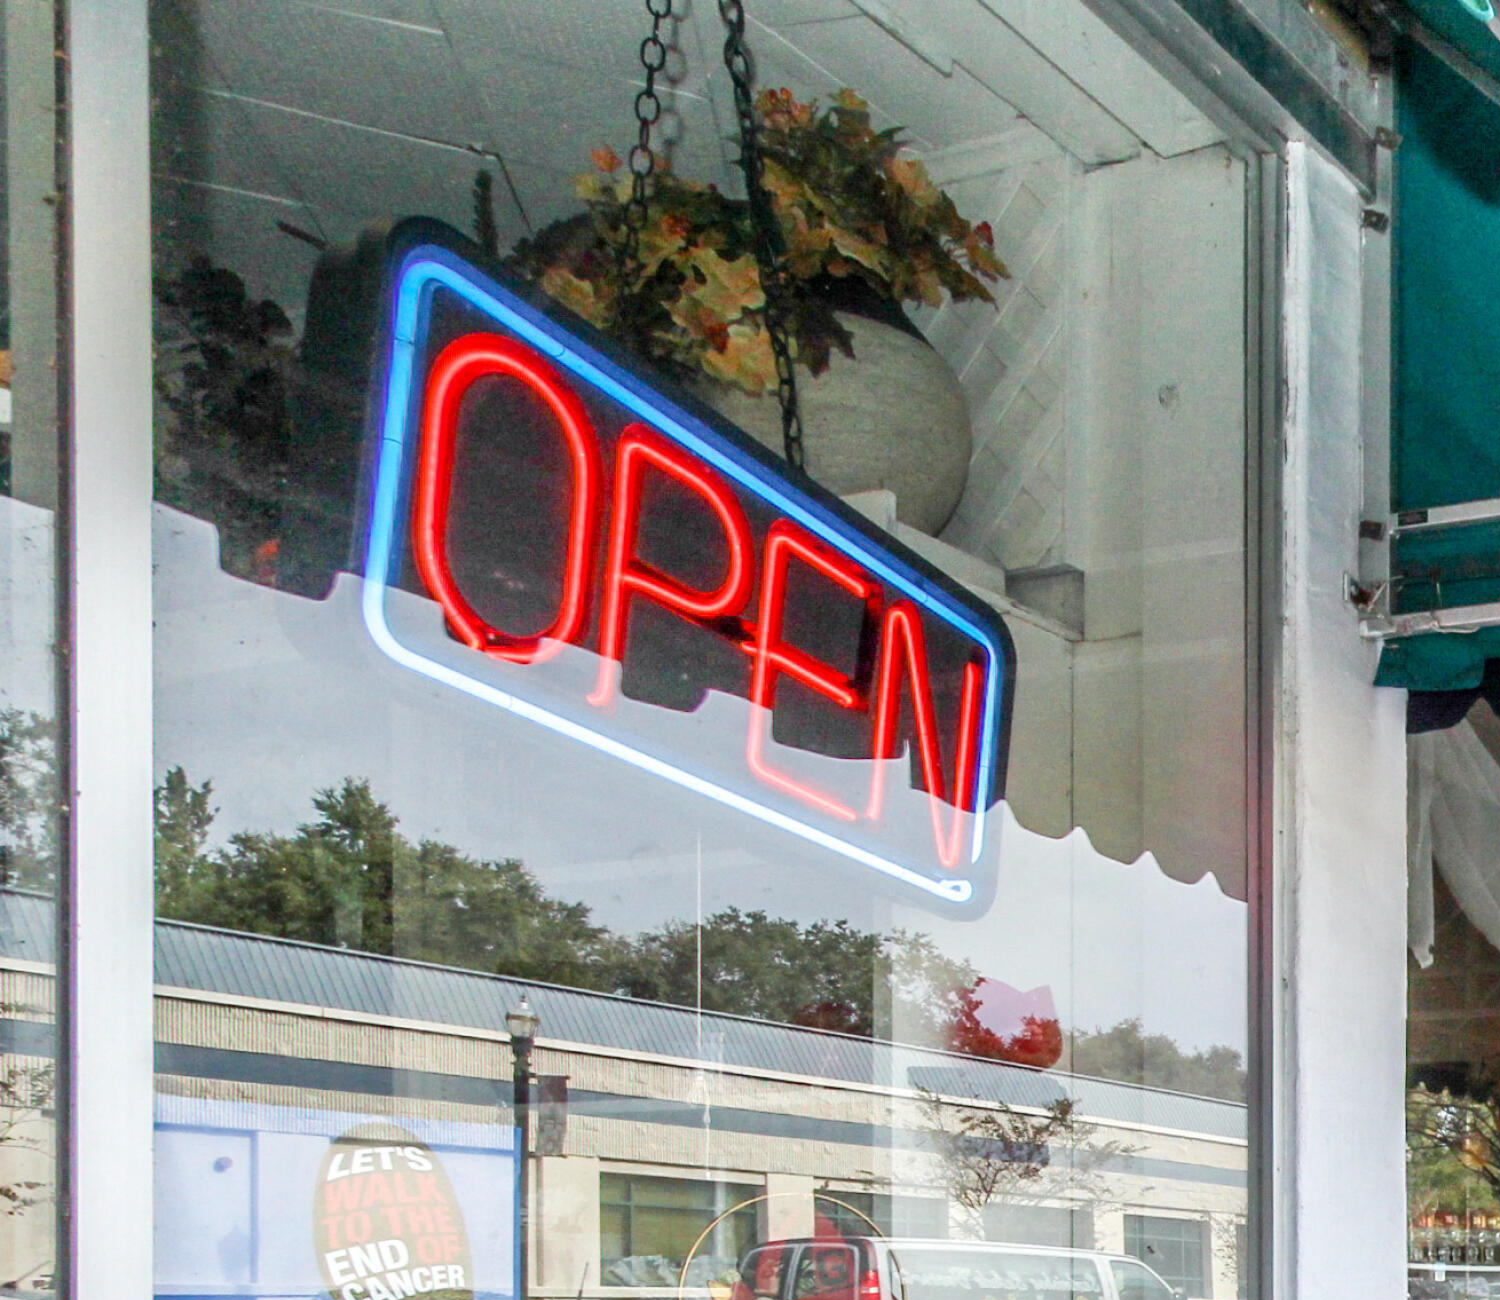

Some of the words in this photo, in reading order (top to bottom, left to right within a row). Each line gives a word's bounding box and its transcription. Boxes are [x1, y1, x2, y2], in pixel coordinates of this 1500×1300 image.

[413, 332, 981, 867] OPEN
[326, 1146, 433, 1182] LET'S
[323, 1172, 445, 1214] WALK
[321, 1210, 373, 1250] TO
[380, 1205, 458, 1236] THE
[324, 1239, 409, 1287] END
[416, 1234, 460, 1263] OF
